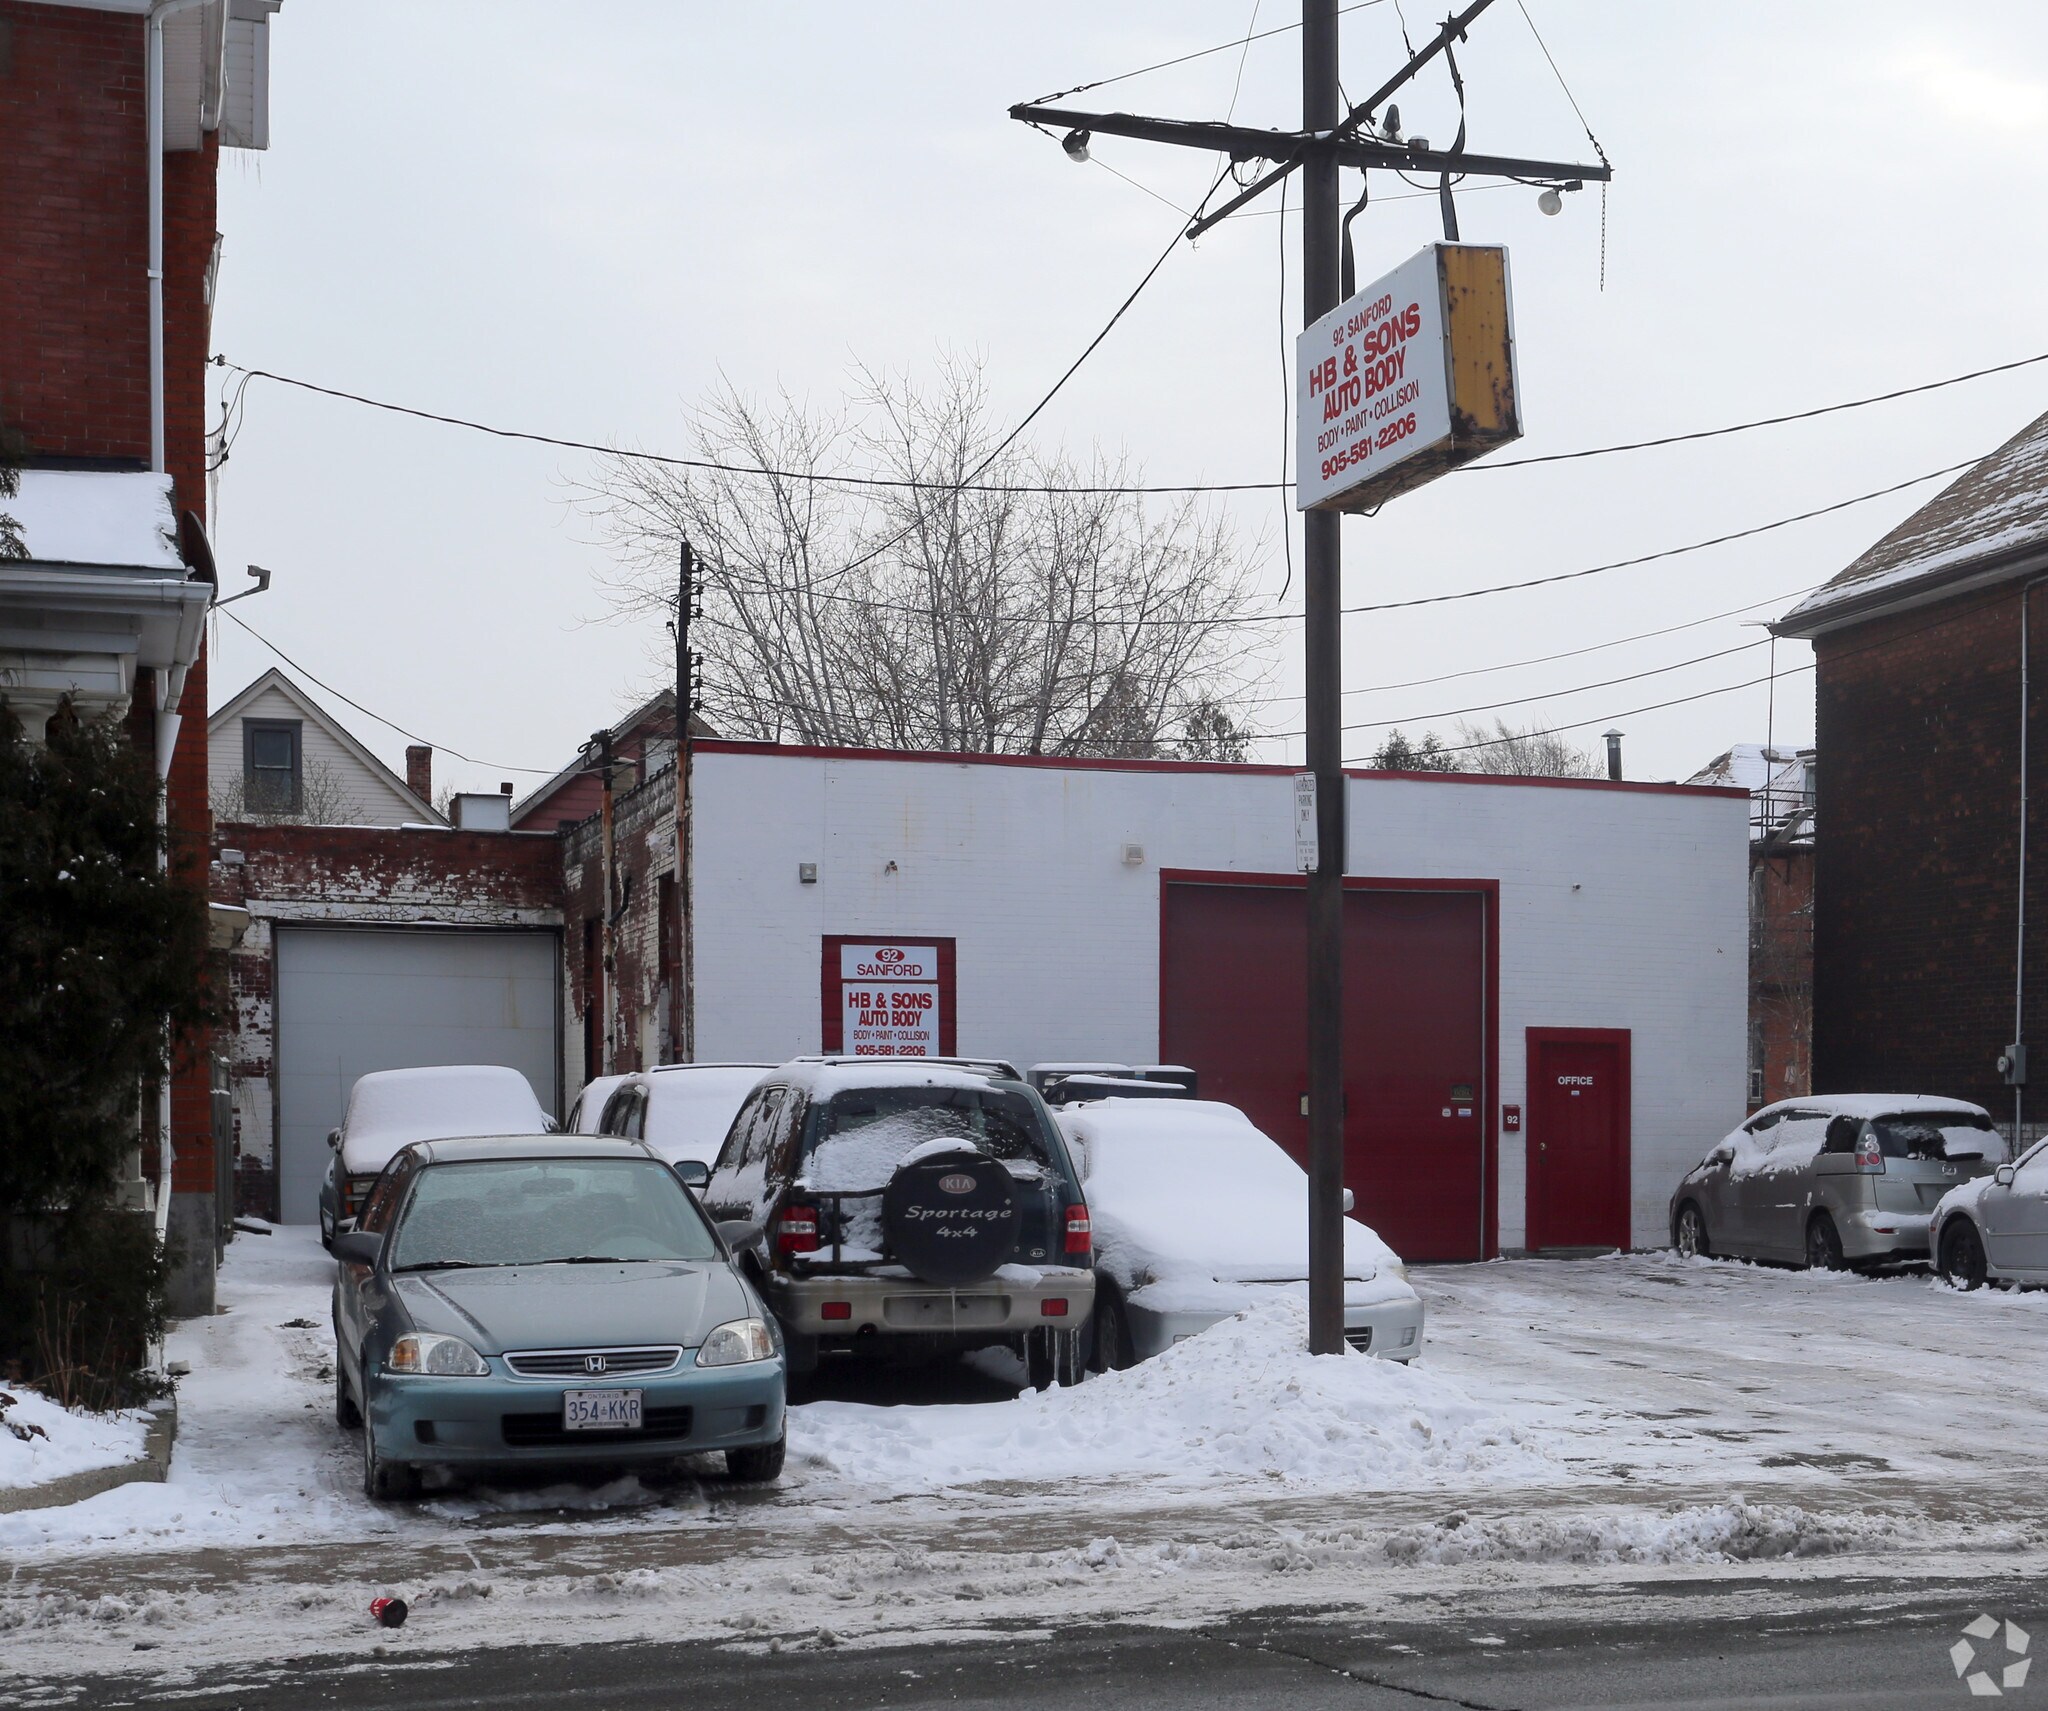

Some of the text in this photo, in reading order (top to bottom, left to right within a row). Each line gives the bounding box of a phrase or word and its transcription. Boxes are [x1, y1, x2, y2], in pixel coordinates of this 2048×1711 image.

[1333, 294, 1392, 347] 92 SANFORD
[1310, 302, 1420, 398] HB & SONS
[1323, 345, 1406, 424] AUTO BODY
[1318, 379, 1419, 453] BODY PAINT COLLISION
[1321, 412, 1416, 480] 905-581-2206
[882, 949, 898, 962] 92
[857, 964, 922, 976] SANFORD
[848, 992, 932, 1009] HB & SONS
[859, 1010, 922, 1027] AUTO BODY
[853, 1030, 930, 1041] BODY PAINT COLLISION
[855, 1045, 926, 1056] 905-581-2206
[1557, 1076, 1593, 1085] OFFICE
[1507, 1116, 1518, 1124] 92
[945, 1178, 972, 1189] KIA
[905, 1205, 1012, 1221] Sportage
[936, 1225, 978, 1238] 4x4
[569, 1400, 639, 1421] 354 KKR
